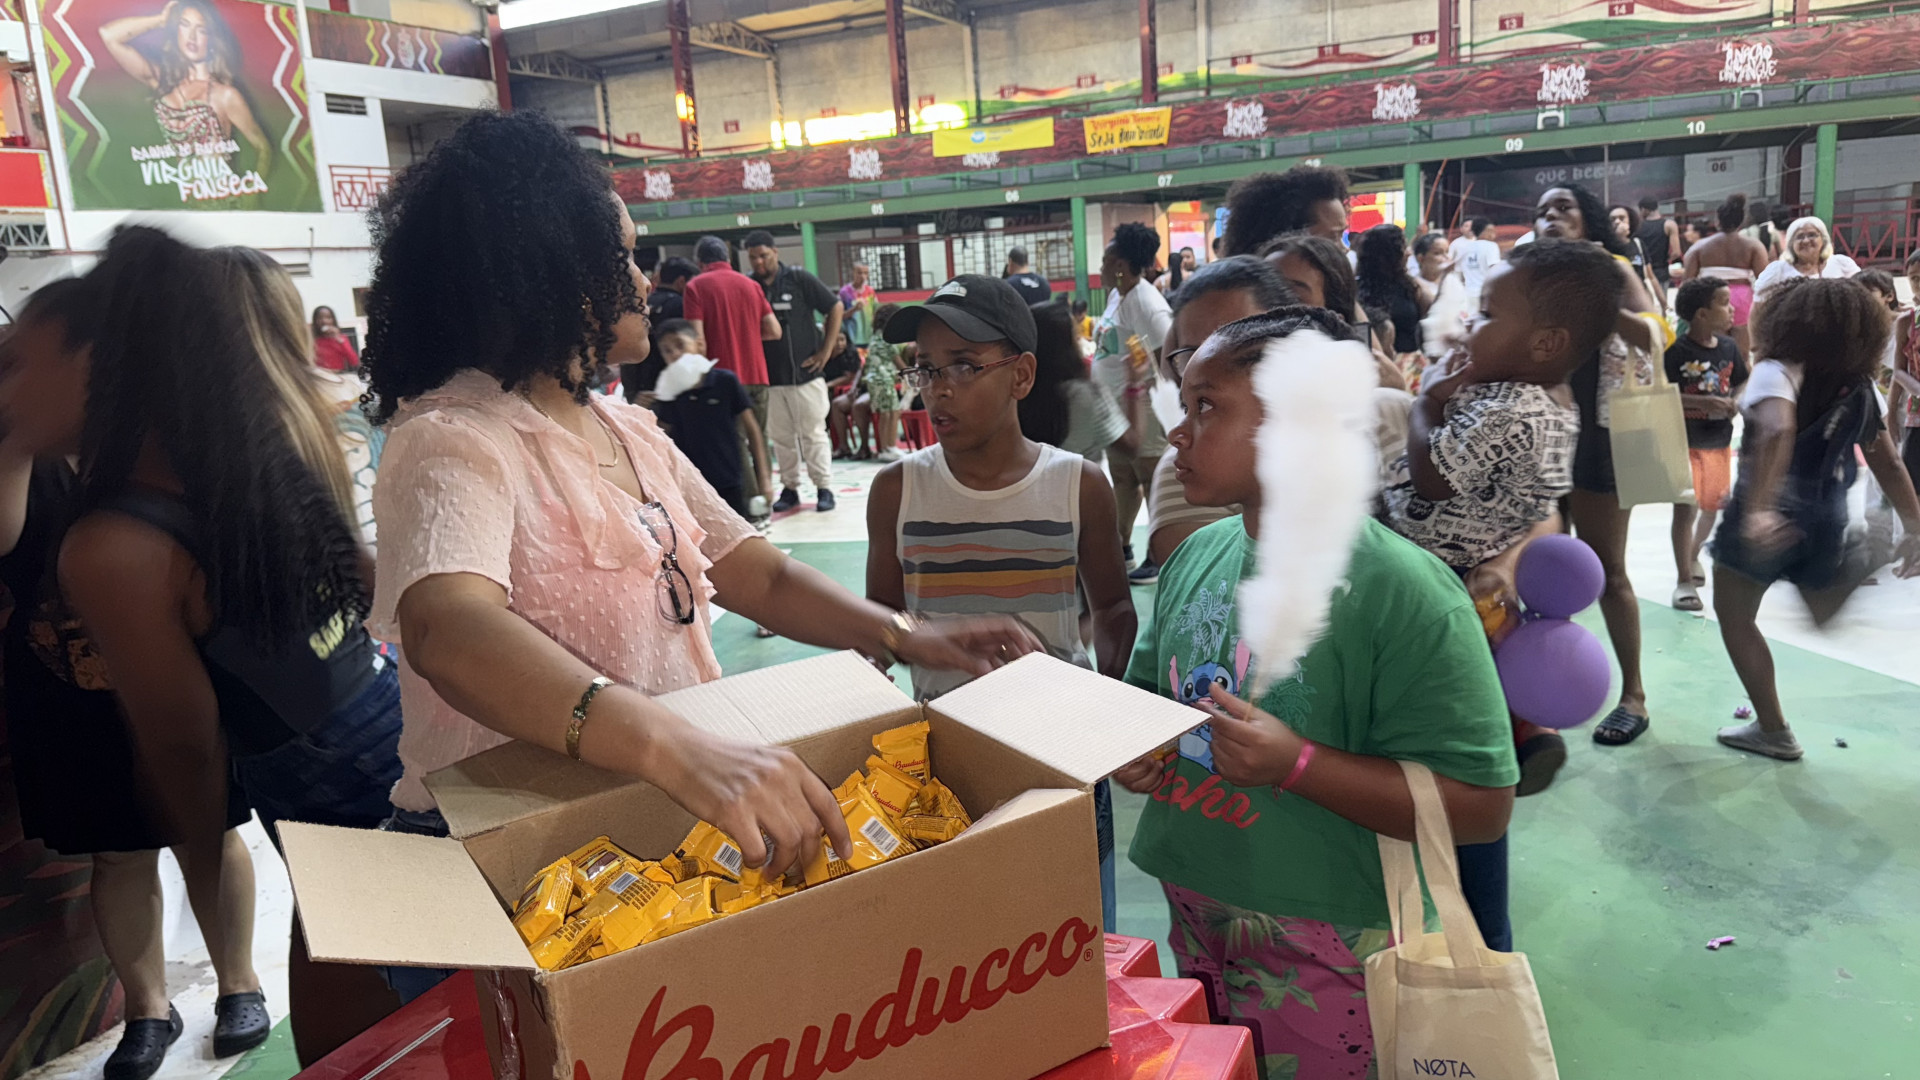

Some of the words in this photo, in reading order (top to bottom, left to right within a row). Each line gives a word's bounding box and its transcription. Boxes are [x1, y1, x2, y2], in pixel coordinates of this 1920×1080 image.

[1613, 4, 1627, 15] 14
[1504, 18, 1517, 30] 13
[1687, 121, 1705, 135] 10
[1505, 138, 1523, 152] 09
[140, 156, 233, 186] VIRGINIA
[1711, 162, 1727, 173] 06
[1157, 174, 1173, 187] 07
[573, 916, 1098, 1080] Bauducco
[1412, 1058, 1476, 1078] NØTA
